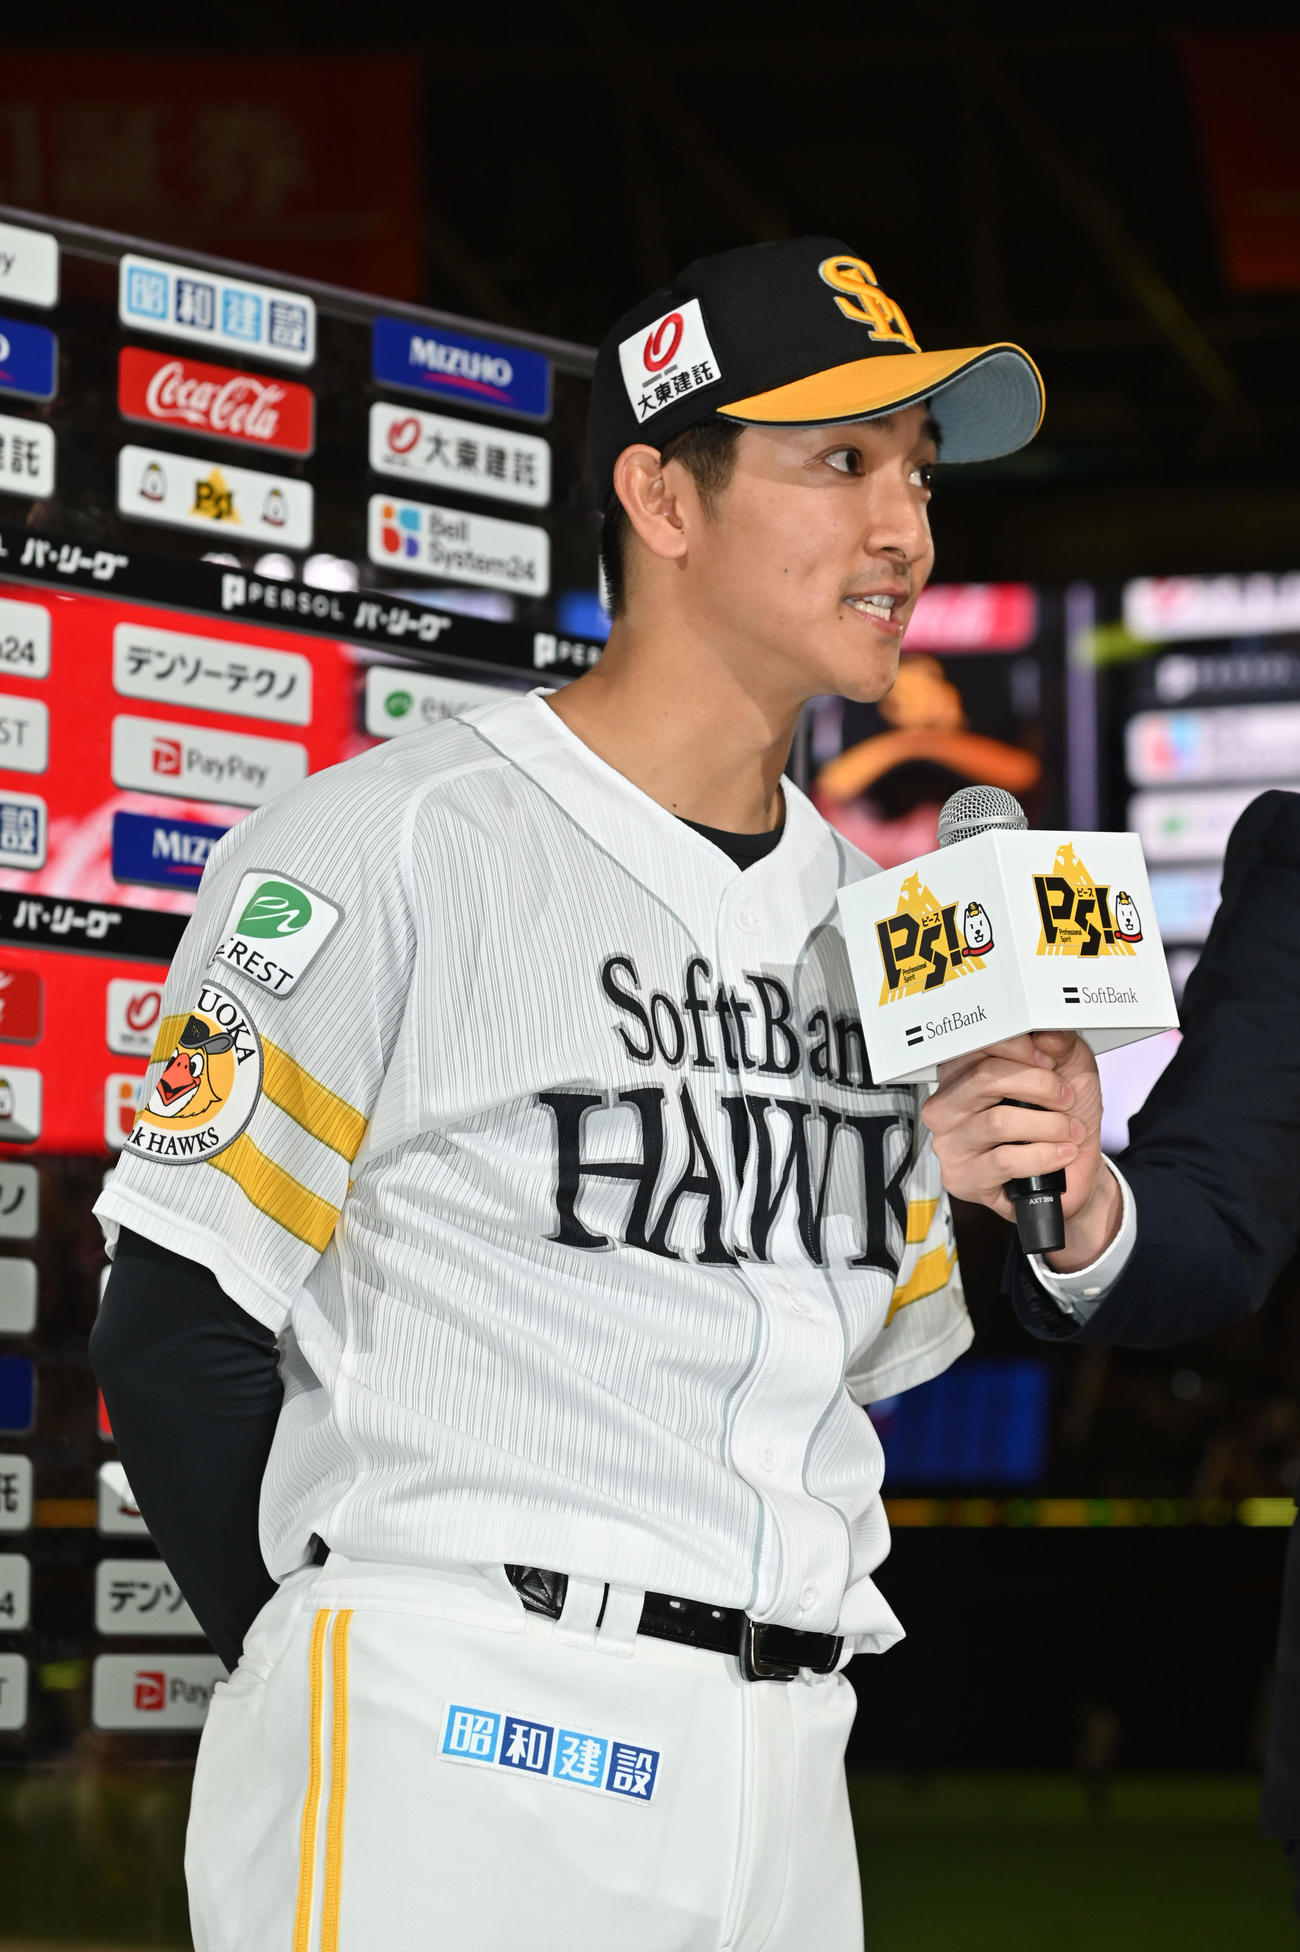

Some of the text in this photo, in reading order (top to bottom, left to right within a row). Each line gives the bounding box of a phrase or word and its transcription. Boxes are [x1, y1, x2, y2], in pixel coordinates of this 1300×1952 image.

[127, 265, 308, 352] 昭和建設
[638, 361, 714, 418] 大東建託
[424, 431, 538, 488] 大東建託
[429, 512, 469, 541] Bell
[428, 541, 537, 582] System24
[249, 582, 344, 620] PERSOL
[126, 645, 297, 700] デンソーテクノ
[186, 750, 268, 787] PayPay
[1082, 987, 1138, 1004] SoftBank
[195, 988, 256, 1066] UOKA
[601, 952, 886, 1092] SoftBan
[925, 1006, 987, 1039] SoftBank
[146, 1126, 219, 1156] HAWKS
[1029, 1197, 1042, 1206] AXT
[447, 1710, 654, 1798] 昭和建設
